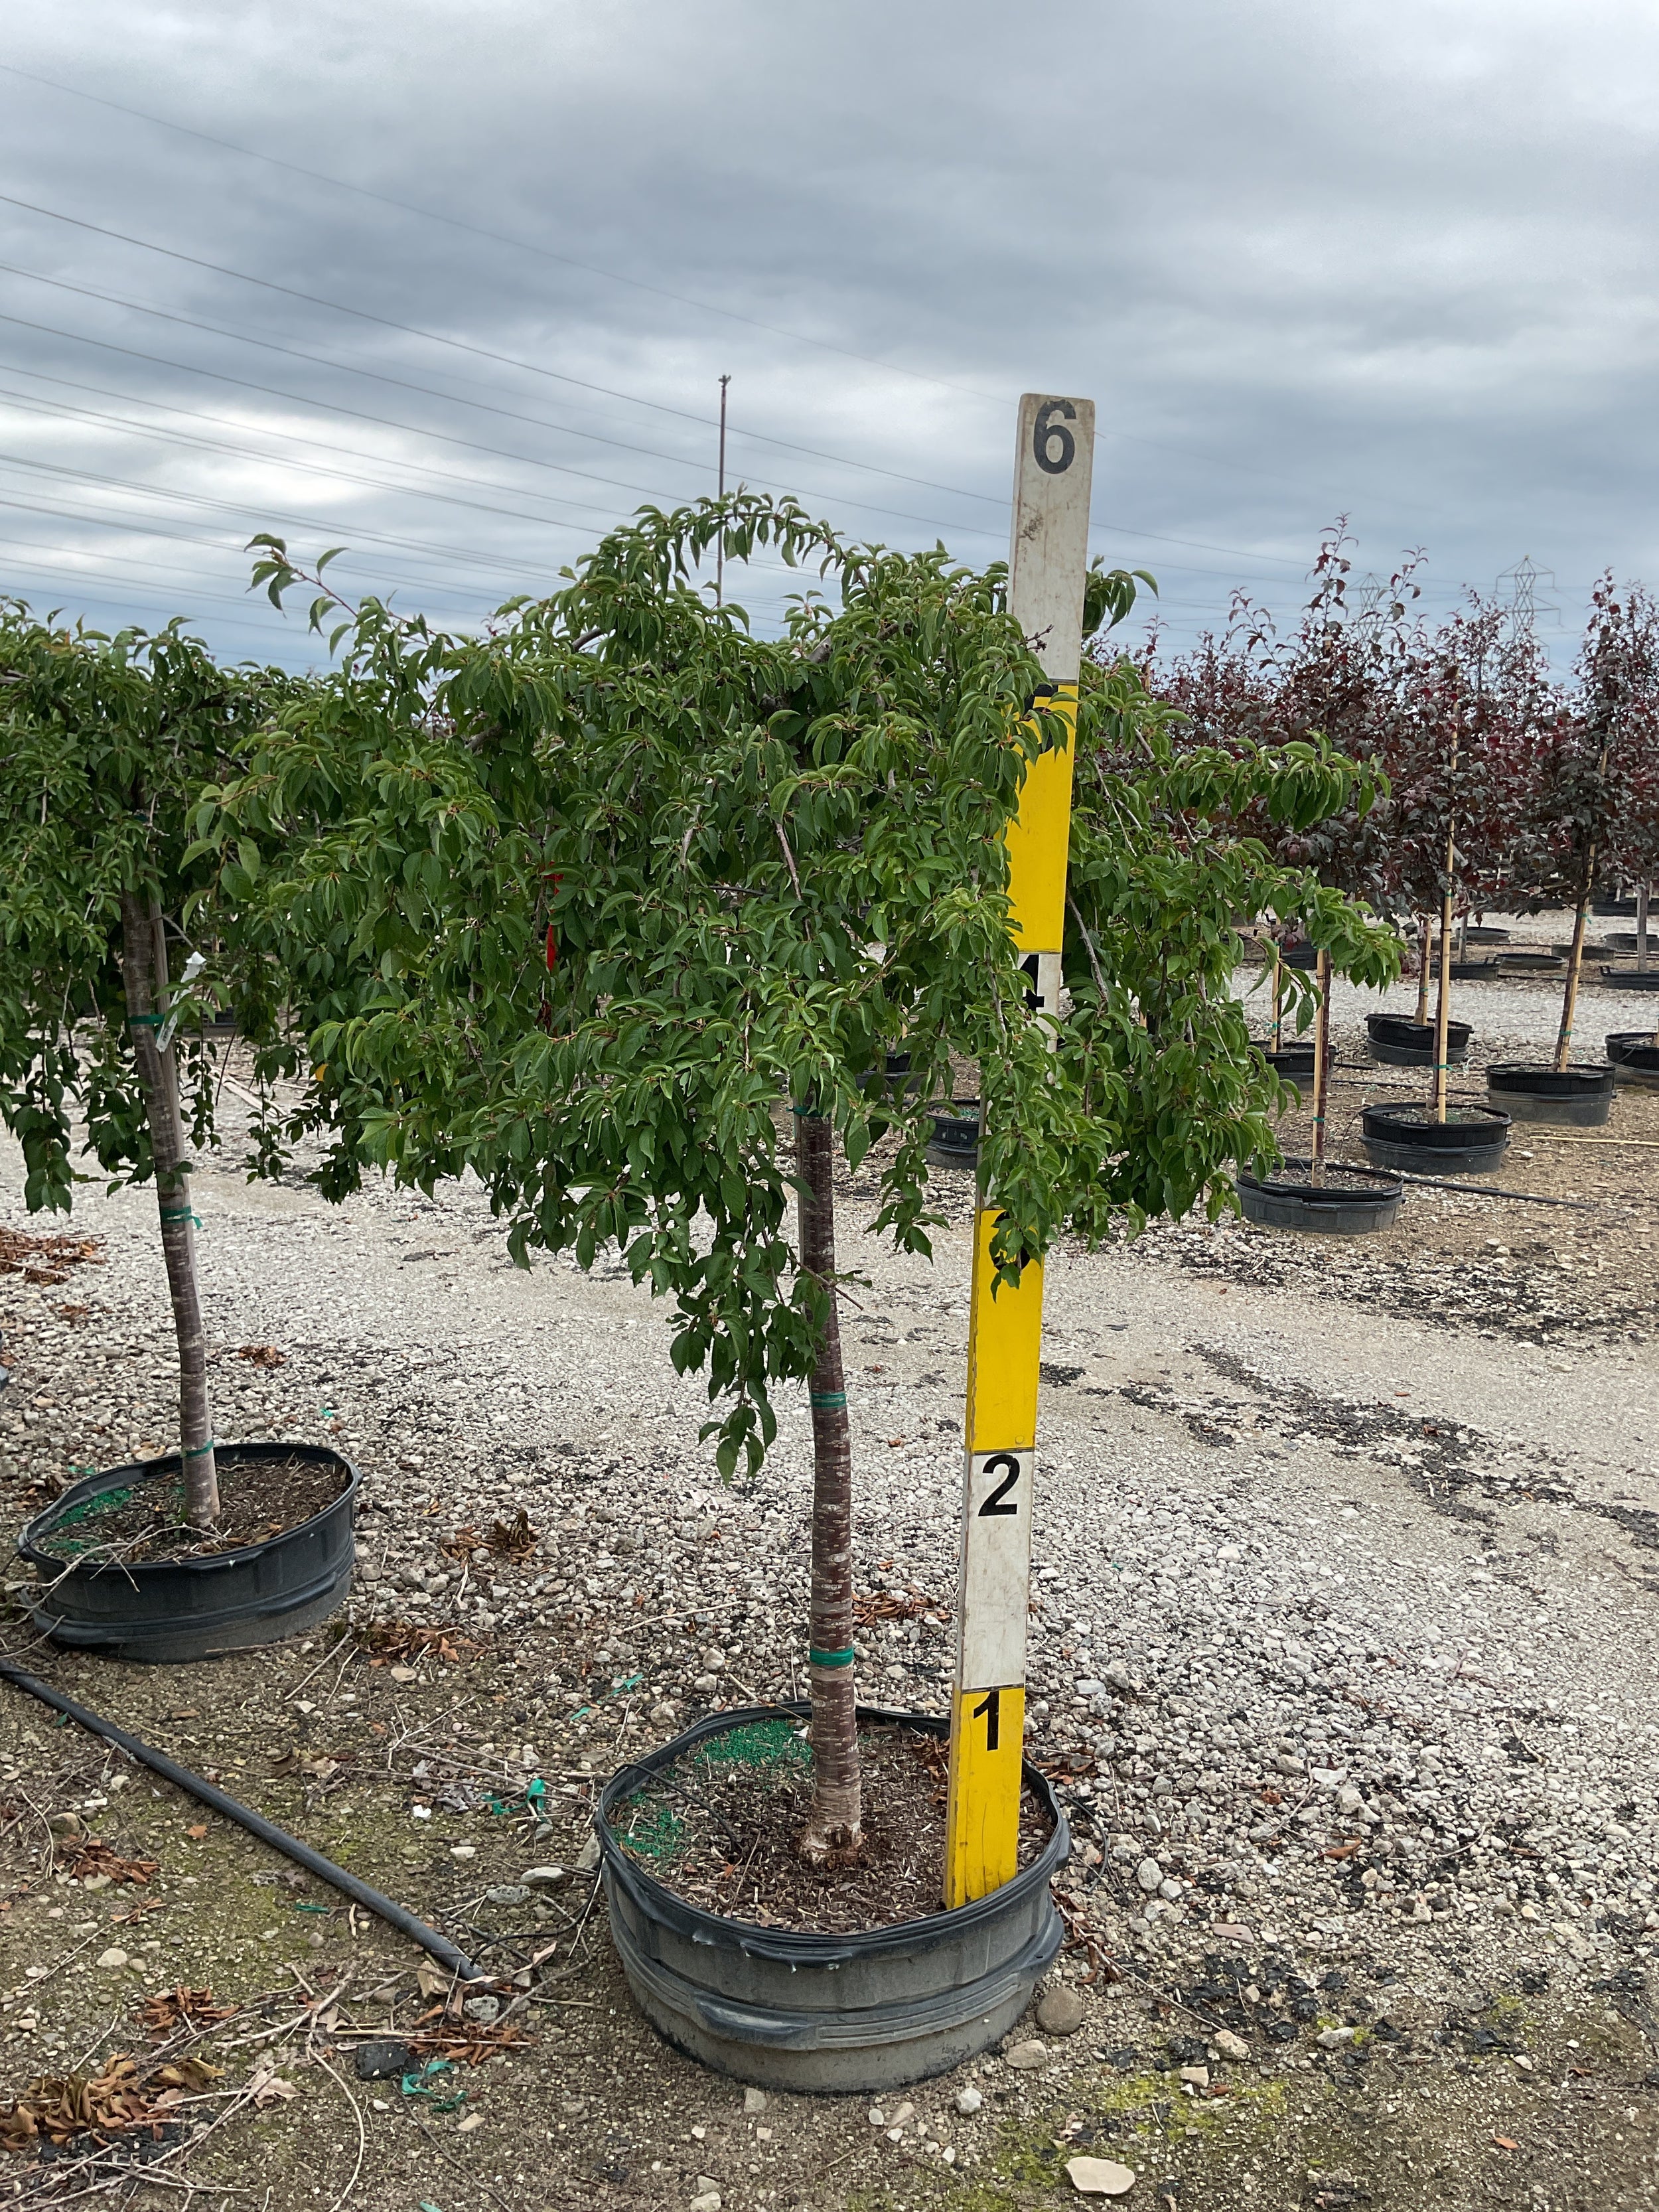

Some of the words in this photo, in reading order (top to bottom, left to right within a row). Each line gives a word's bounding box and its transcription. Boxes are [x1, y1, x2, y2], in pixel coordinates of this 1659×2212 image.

[1033, 399, 1076, 475] 6
[978, 1454, 1020, 1516] 2
[973, 1690, 1000, 1751] 1
